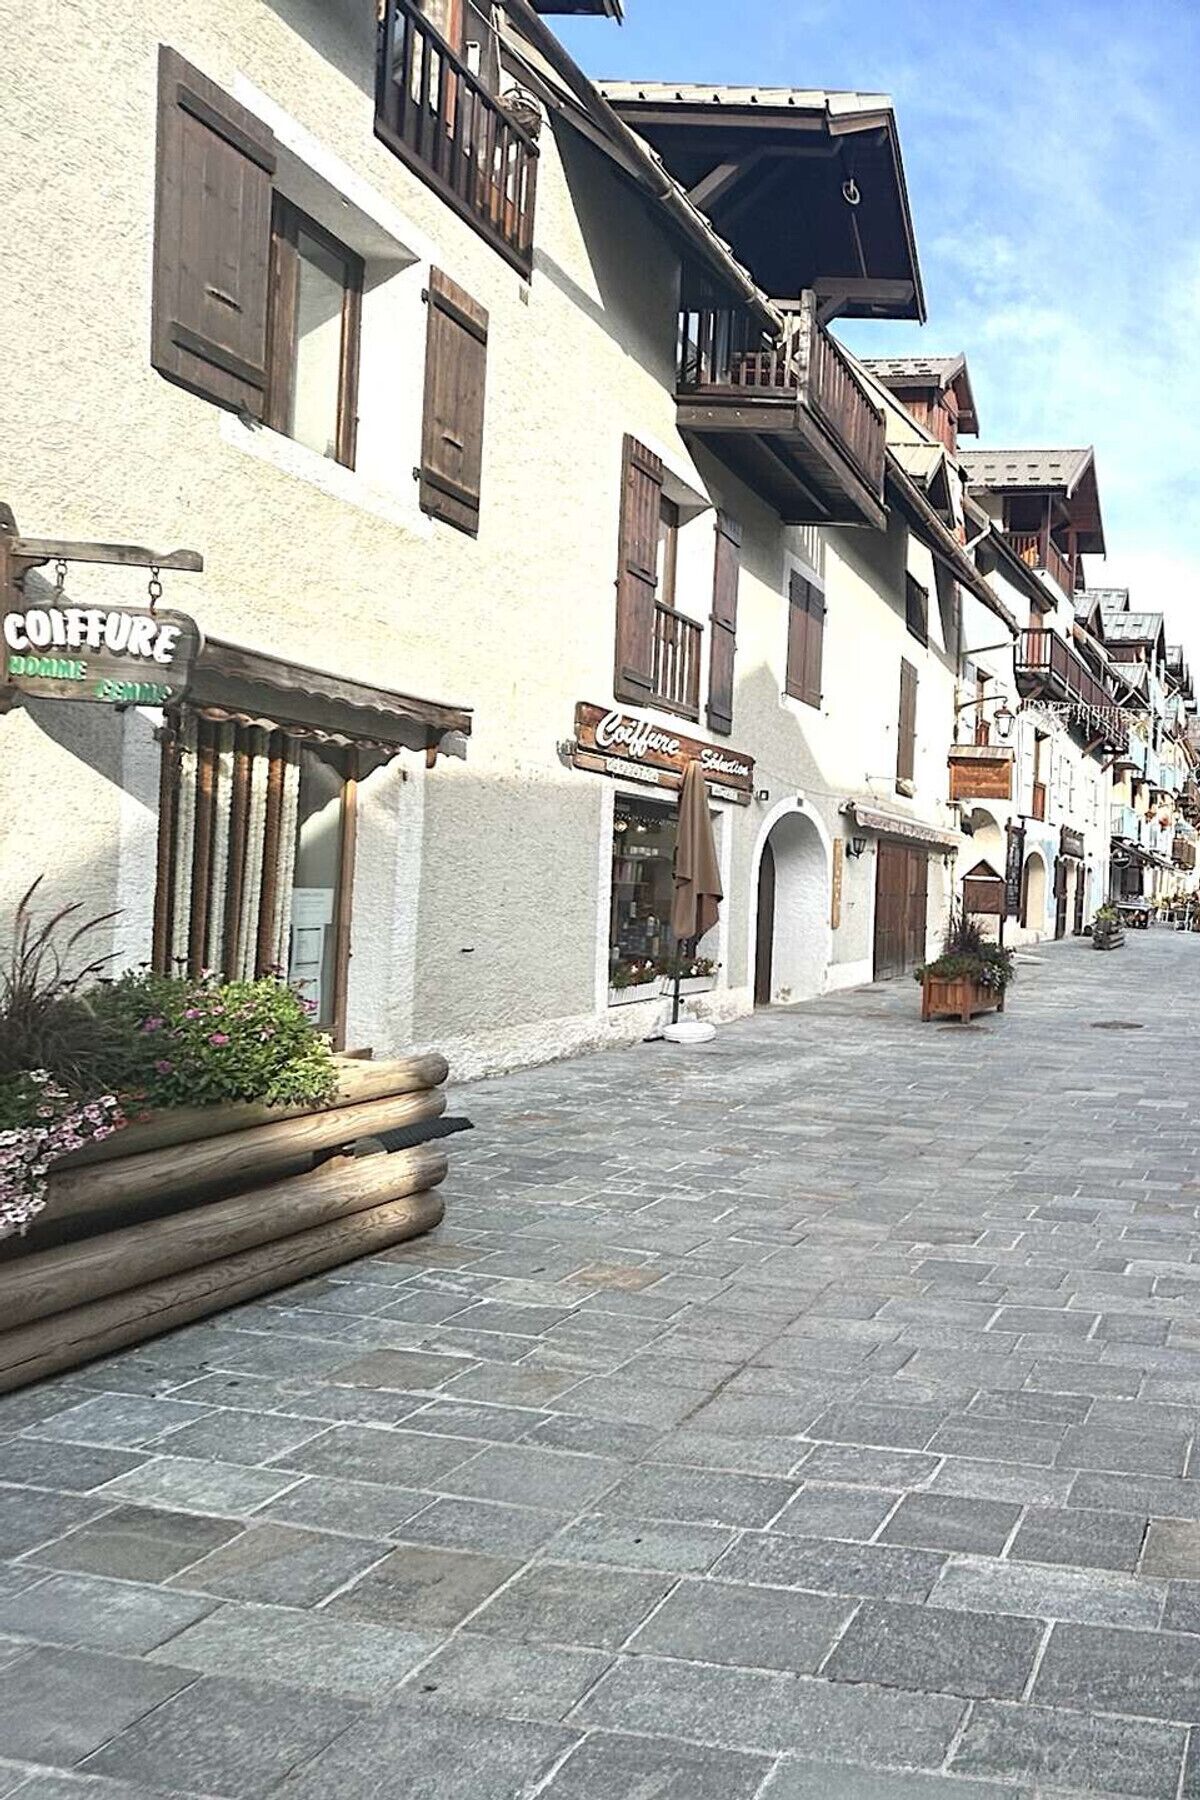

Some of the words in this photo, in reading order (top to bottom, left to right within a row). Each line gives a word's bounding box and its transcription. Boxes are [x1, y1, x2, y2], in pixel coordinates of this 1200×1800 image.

[3, 608, 183, 664] COIFFURE
[8, 655, 88, 681] HOMME
[595, 711, 681, 758] Coiffure
